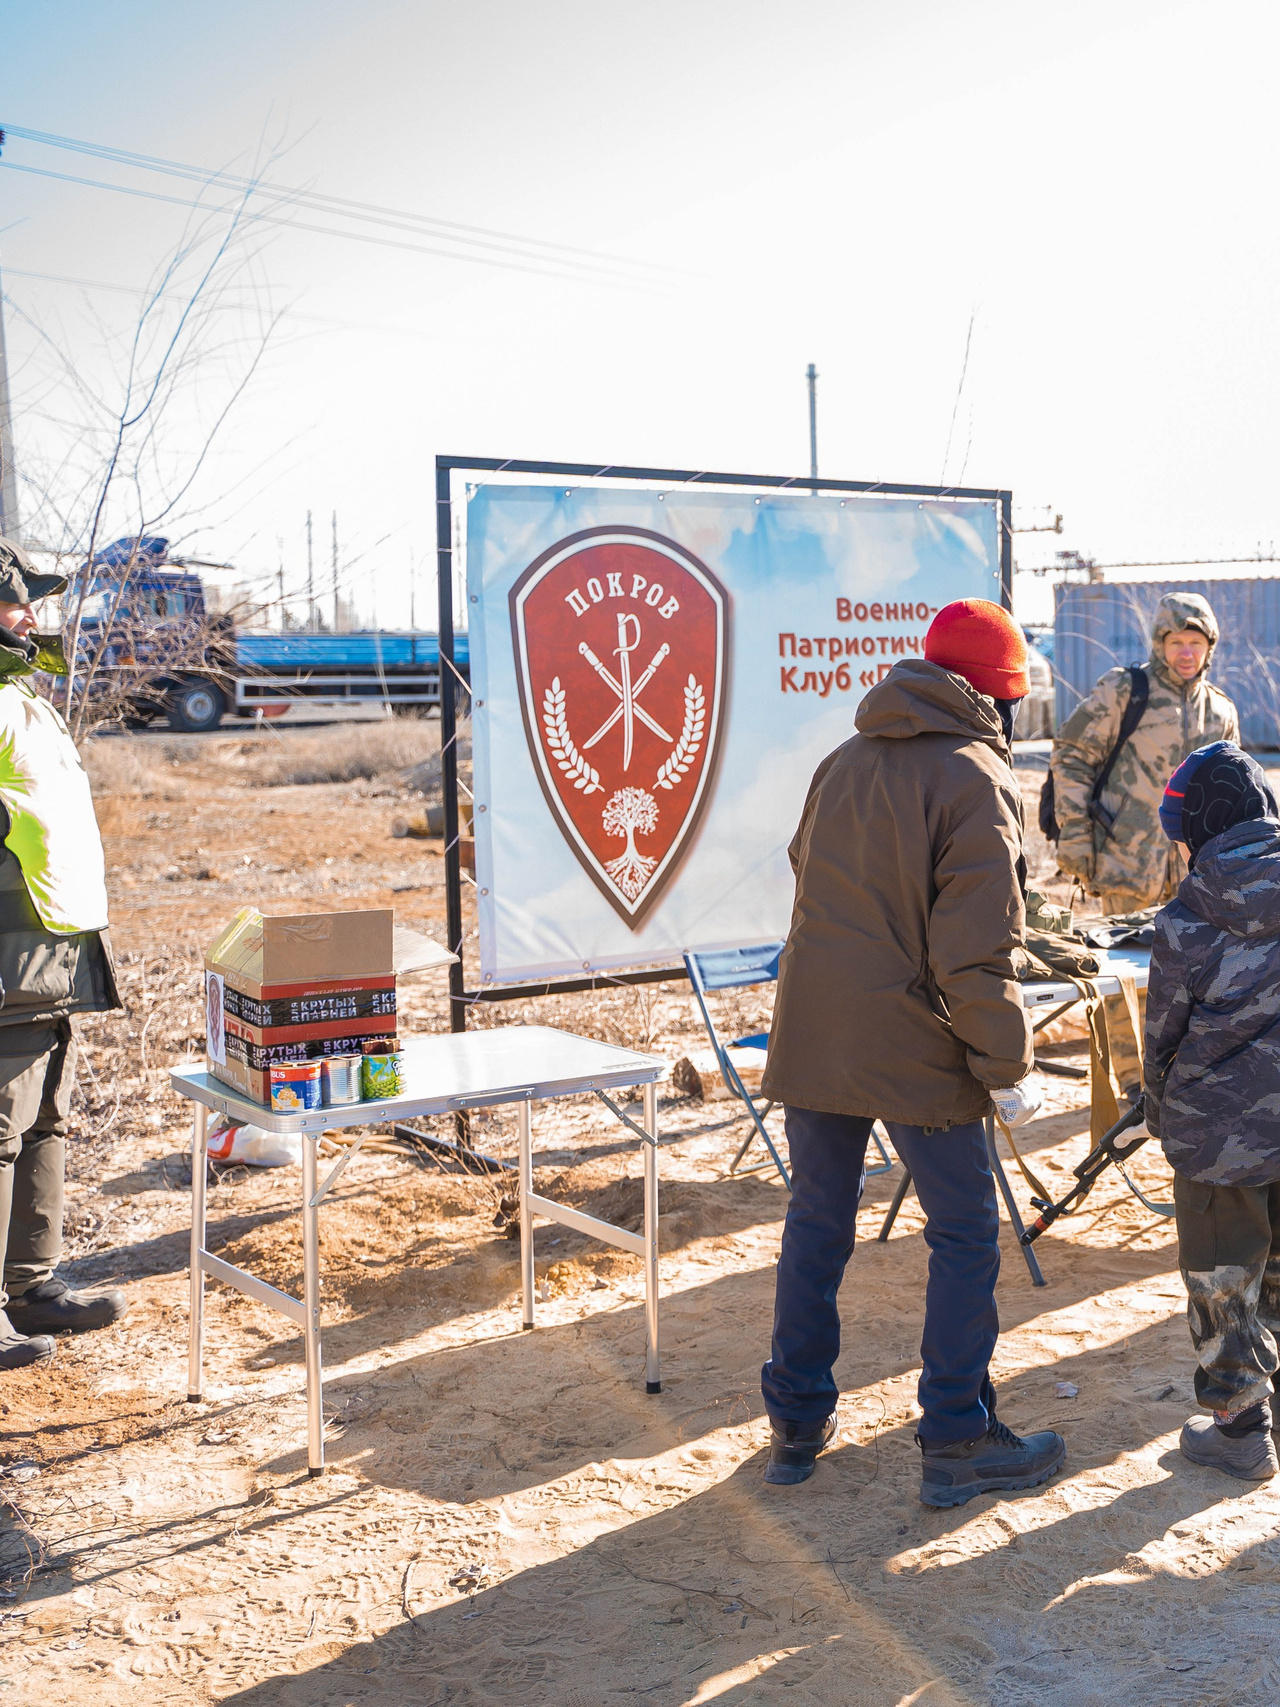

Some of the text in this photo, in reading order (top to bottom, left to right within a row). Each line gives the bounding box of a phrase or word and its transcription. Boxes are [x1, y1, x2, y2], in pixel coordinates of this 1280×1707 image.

[564, 572, 680, 619] ПОКРОВ
[836, 598, 938, 623] Военно-
[778, 632, 926, 662] Патриотич
[780, 661, 852, 698] Клуб
[301, 996, 356, 1012] КРУТЫХ
